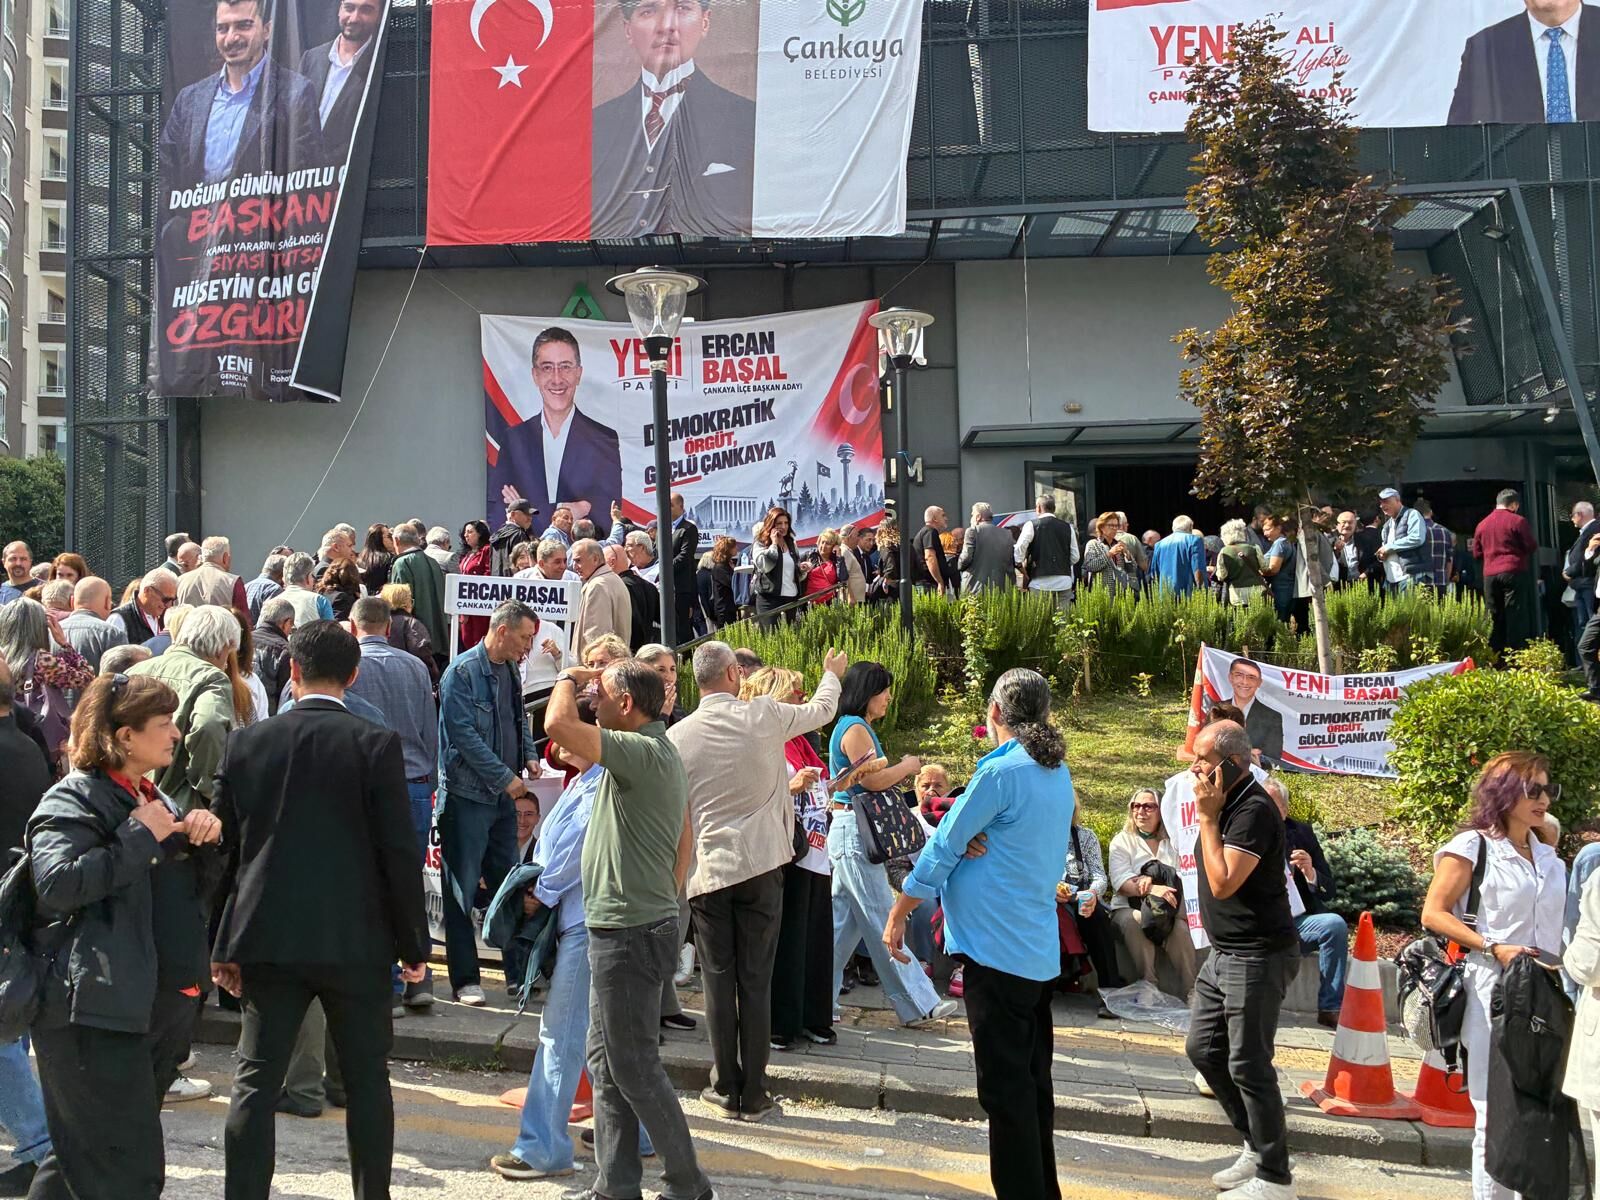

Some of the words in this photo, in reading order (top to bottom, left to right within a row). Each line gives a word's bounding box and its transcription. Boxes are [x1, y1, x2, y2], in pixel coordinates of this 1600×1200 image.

[783, 33, 903, 63] Çankaya
[805, 65, 882, 79] BELEDİYESİ
[169, 181, 228, 210] DOĞUM
[229, 171, 284, 198] GÜNÜN
[286, 165, 335, 192] KUTLU
[206, 244, 231, 256] KAMU
[172, 272, 255, 308] HÜSEYİN
[258, 273, 293, 299] CAN
[701, 331, 775, 359] ERCAN
[702, 354, 788, 385] BAŞAL
[703, 385, 736, 396] ÇANKAYA
[737, 384, 751, 395] İLÇE
[753, 383, 781, 394] BAŞKAN
[782, 382, 803, 391] ADAYI
[684, 431, 738, 455] ÖRGÜT,
[644, 453, 698, 485] GÇLÜ
[701, 440, 777, 476] ÇANKAYA
[458, 582, 512, 601] ERCAN
[516, 585, 568, 605] BAŞAL
[457, 601, 493, 610] ÇANKAYA
[545, 606, 568, 614] ADAYI
[1343, 676, 1395, 688] ERCAN
[1300, 707, 1392, 726] DEMOKRATİK
[1298, 732, 1337, 747] GÜÇLÜ
